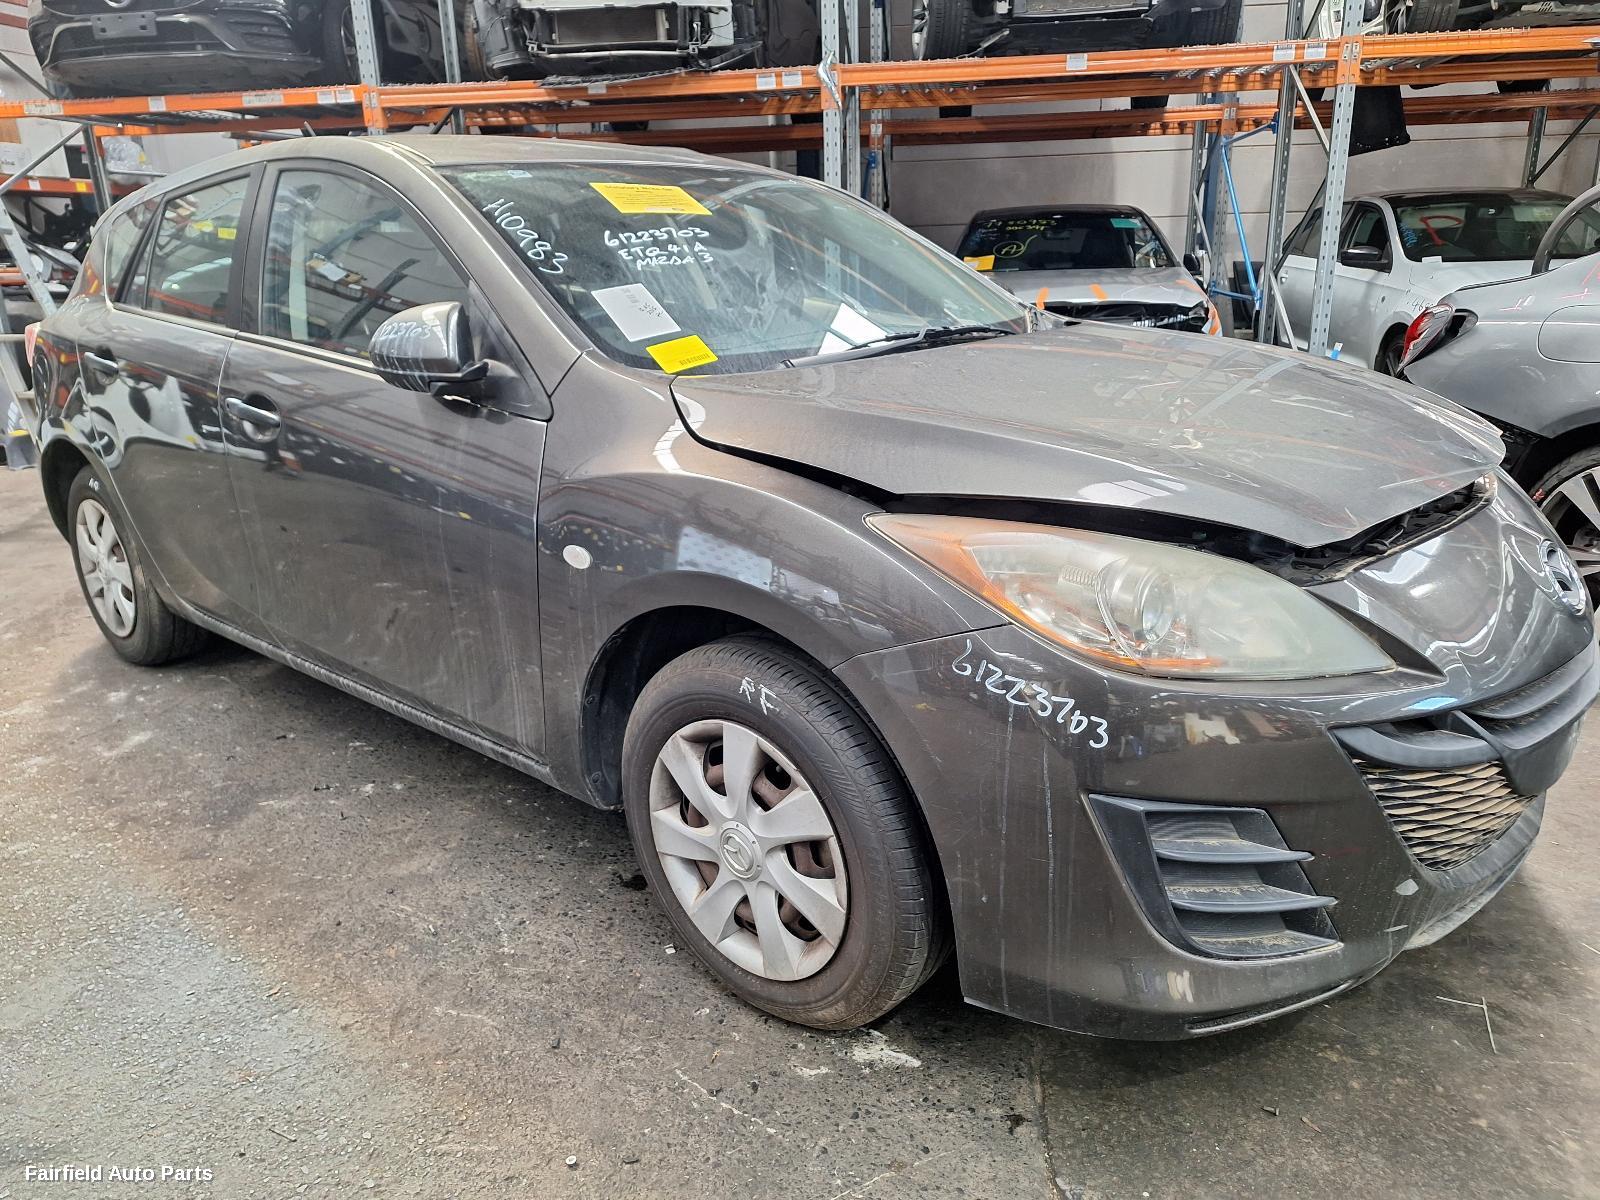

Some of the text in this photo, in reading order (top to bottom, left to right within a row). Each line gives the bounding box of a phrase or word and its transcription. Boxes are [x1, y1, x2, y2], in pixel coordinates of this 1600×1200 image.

[603, 226, 710, 247] 61223703
[636, 251, 714, 271] MAZDA 3
[952, 638, 1109, 749] 61223703
